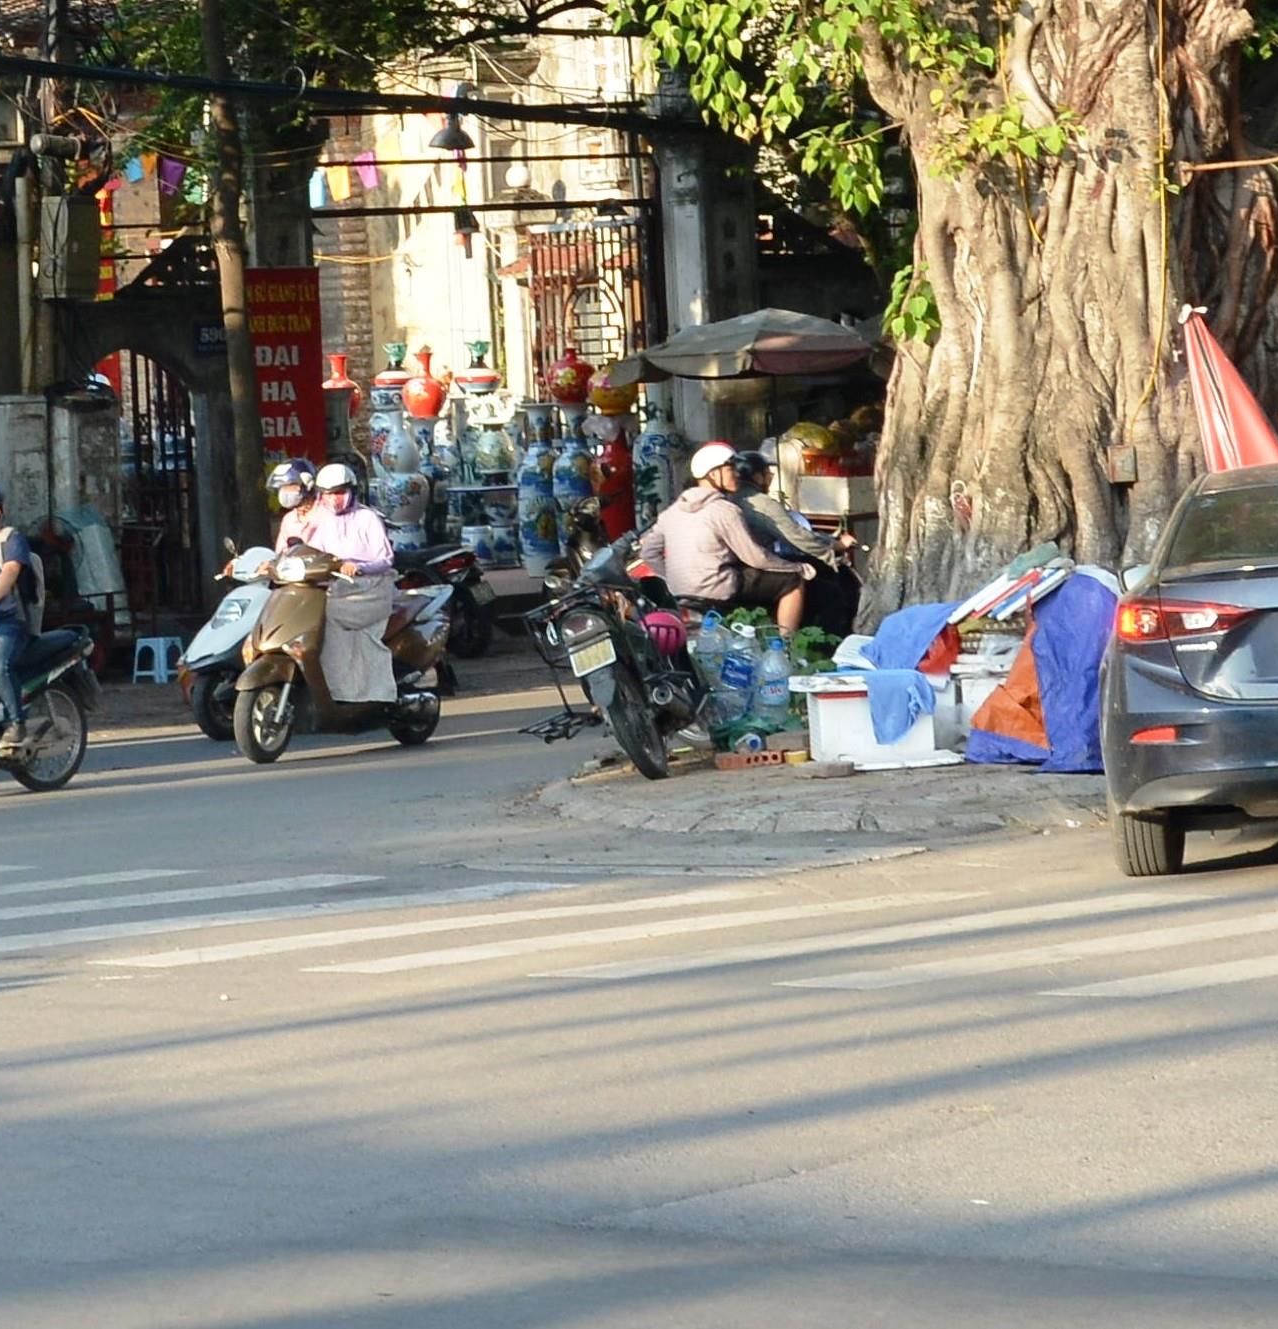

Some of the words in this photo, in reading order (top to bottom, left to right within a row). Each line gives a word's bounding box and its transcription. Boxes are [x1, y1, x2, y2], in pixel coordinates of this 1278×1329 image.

[254, 345, 300, 370] ĐẠI
[262, 381, 297, 405] HẠ
[261, 411, 302, 438] GIÁ
